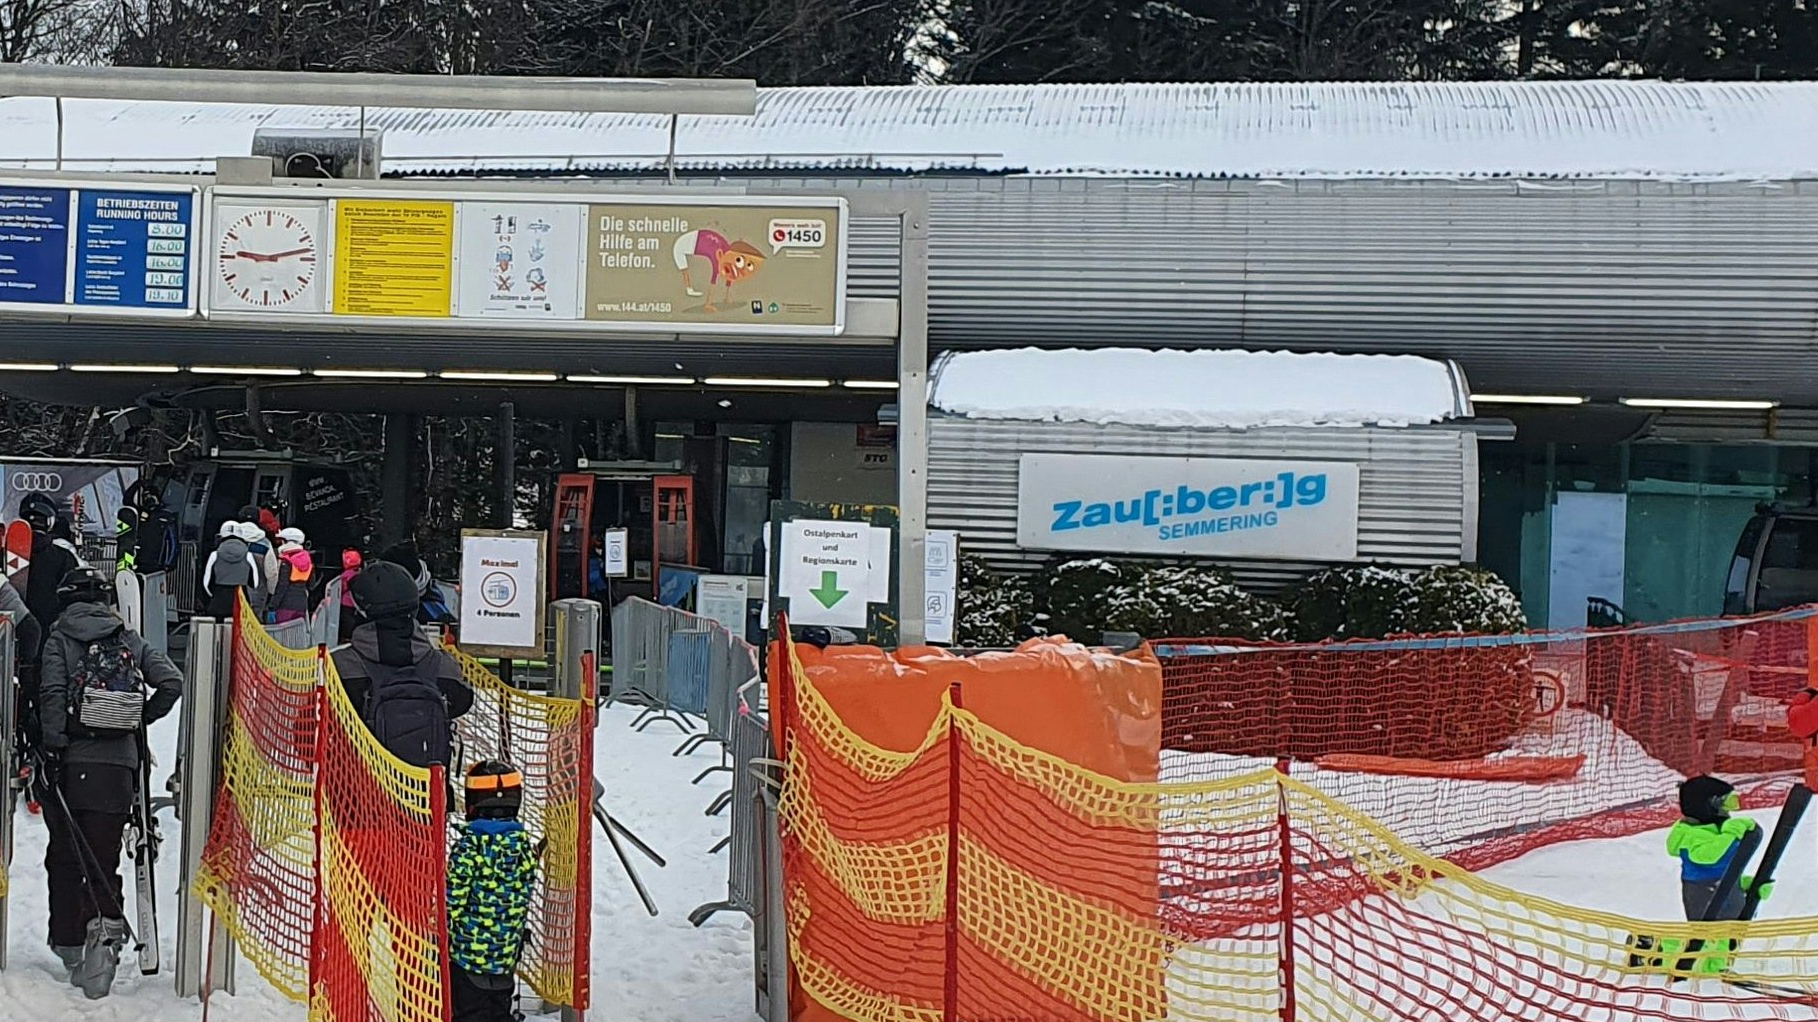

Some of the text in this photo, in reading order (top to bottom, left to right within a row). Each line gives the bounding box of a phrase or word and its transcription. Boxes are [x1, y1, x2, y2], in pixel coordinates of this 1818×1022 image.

[96, 198, 179, 210] BETRIEBSZEITEN
[96, 208, 179, 222] RUNNING HOURS
[600, 216, 689, 233] Die schnelle
[599, 234, 660, 250] Hilfe am
[786, 230, 822, 243] 1450
[598, 251, 656, 268] Telefon.
[597, 302, 672, 313] www.144.at/1450
[1158, 511, 1279, 541] SEMMERING
[822, 544, 839, 552] und
[481, 559, 519, 568] Maximal
[802, 556, 858, 566] Regionskarte
[477, 609, 521, 618] 4 Personen
